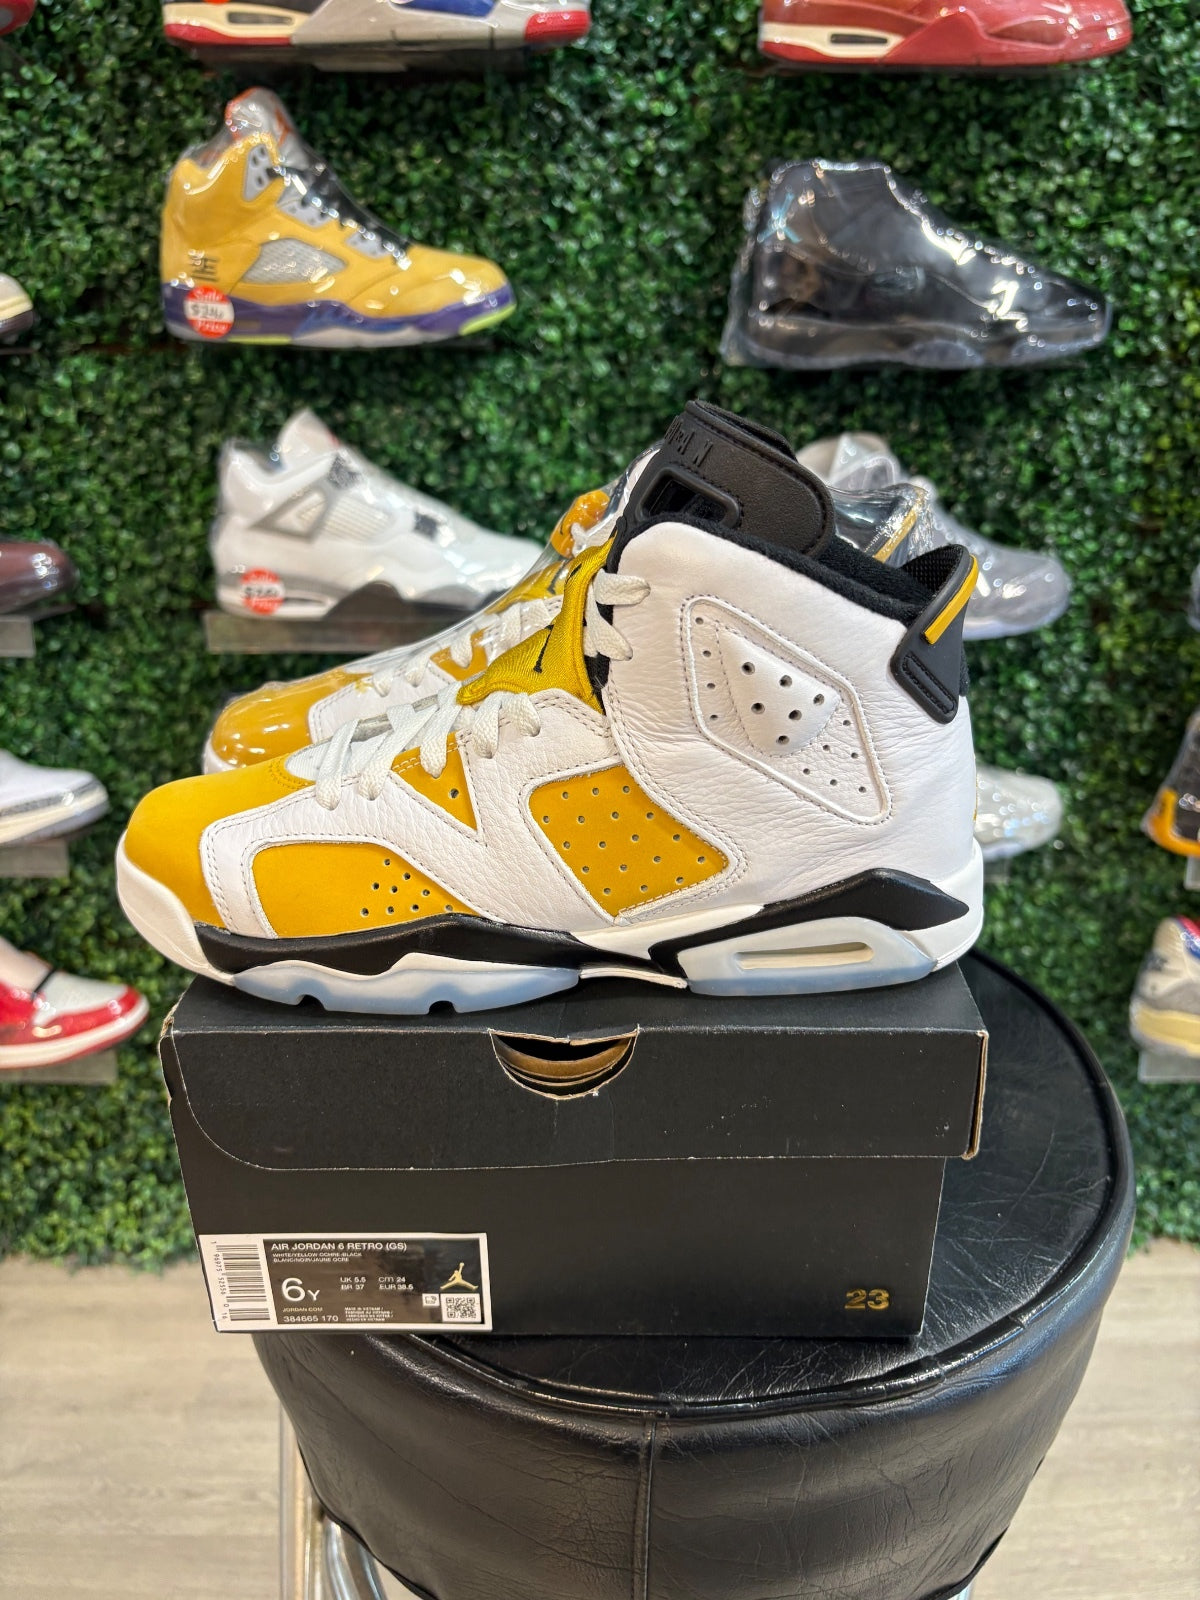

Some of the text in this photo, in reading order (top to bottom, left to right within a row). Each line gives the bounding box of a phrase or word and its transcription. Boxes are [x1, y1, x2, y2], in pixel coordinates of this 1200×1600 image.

[271, 1242, 407, 1253] AIR JORDAN 6 RETRO (GS)
[844, 1288, 890, 1310] 23
[321, 1314, 339, 1322] 170
